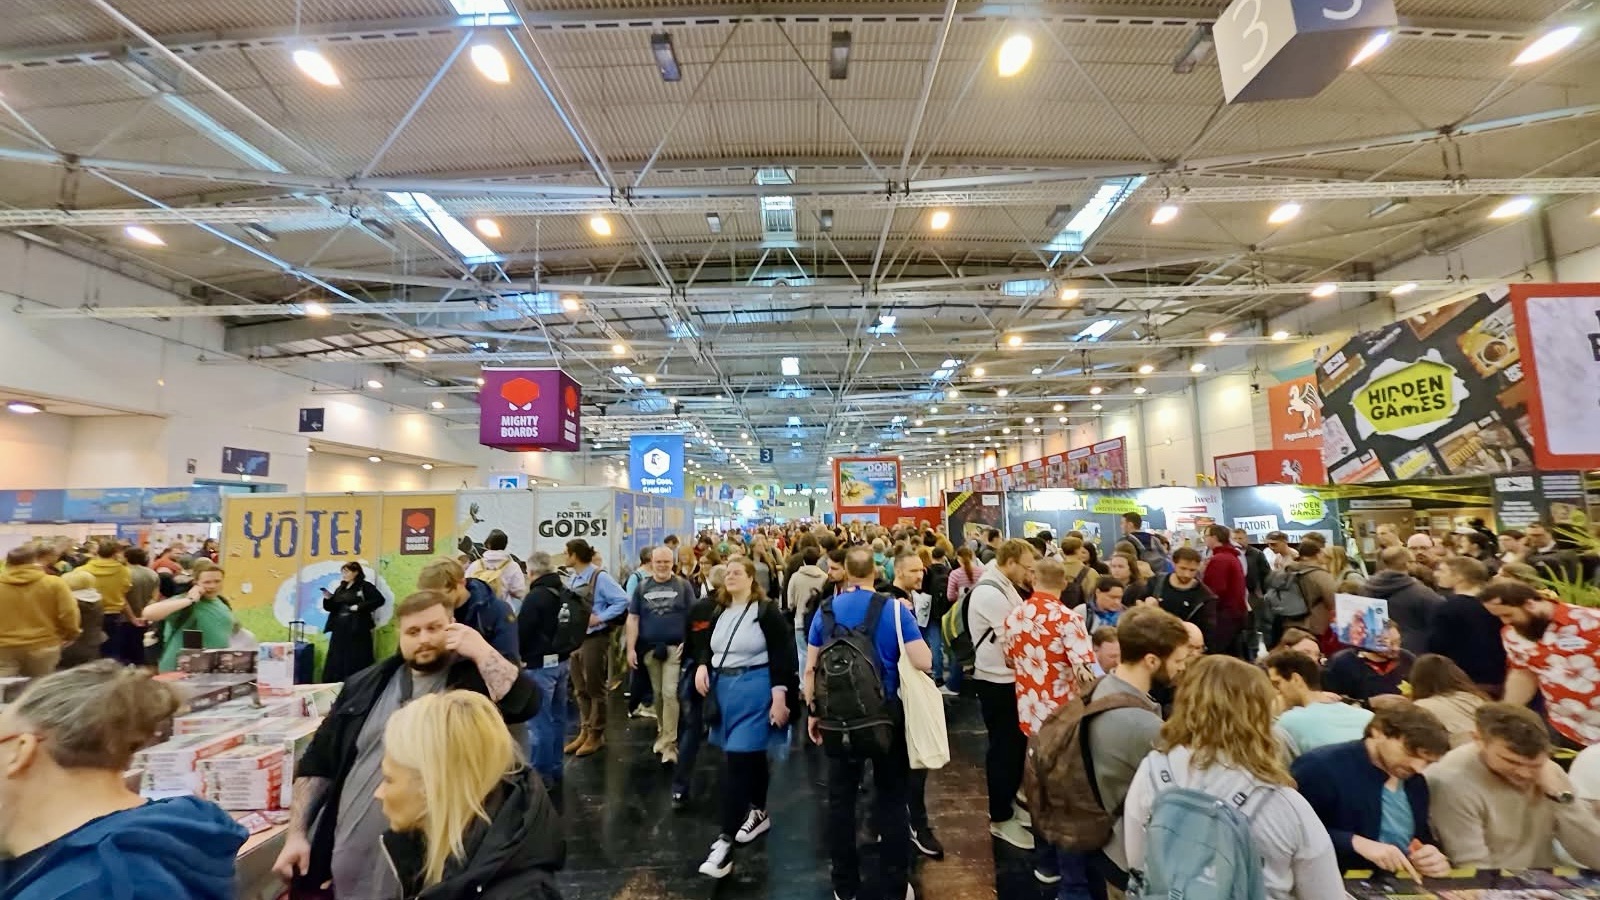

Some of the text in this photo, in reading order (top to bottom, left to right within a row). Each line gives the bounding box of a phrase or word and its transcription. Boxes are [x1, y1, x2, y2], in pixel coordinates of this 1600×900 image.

[1232, 0, 1269, 73] 3
[1368, 375, 1444, 405] HIDDEN
[1370, 393, 1446, 420] GAMES
[501, 415, 539, 427] MIGHTY
[501, 427, 538, 438] BOARDS
[763, 449, 770, 461] 3
[556, 511, 574, 519] FOR
[538, 518, 608, 538] GODS!
